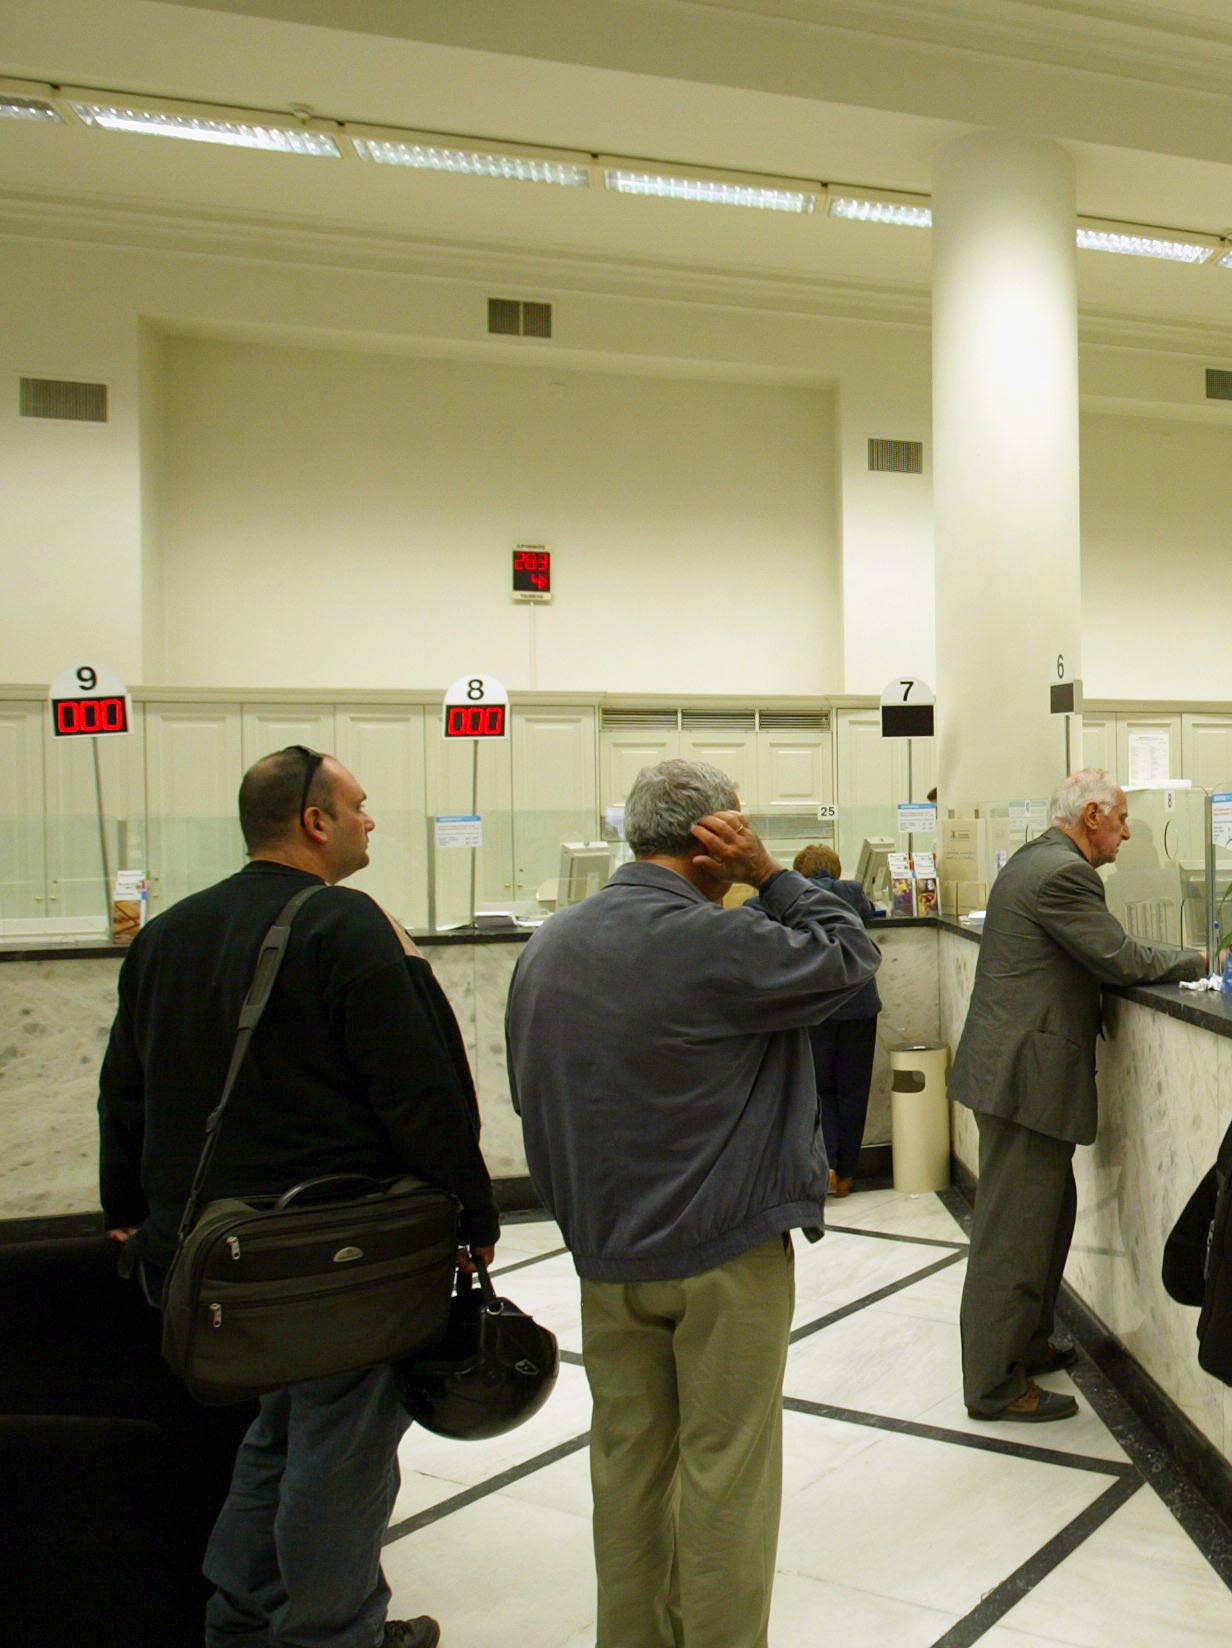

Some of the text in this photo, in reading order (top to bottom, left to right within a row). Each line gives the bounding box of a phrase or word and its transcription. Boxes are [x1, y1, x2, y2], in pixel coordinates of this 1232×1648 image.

[76, 666, 98, 691] 9
[1057, 654, 1065, 680] 6
[467, 679, 485, 701] 8
[900, 681, 914, 702] 7
[58, 698, 123, 733] 000
[447, 706, 503, 736] 000
[820, 806, 835, 817] 25
